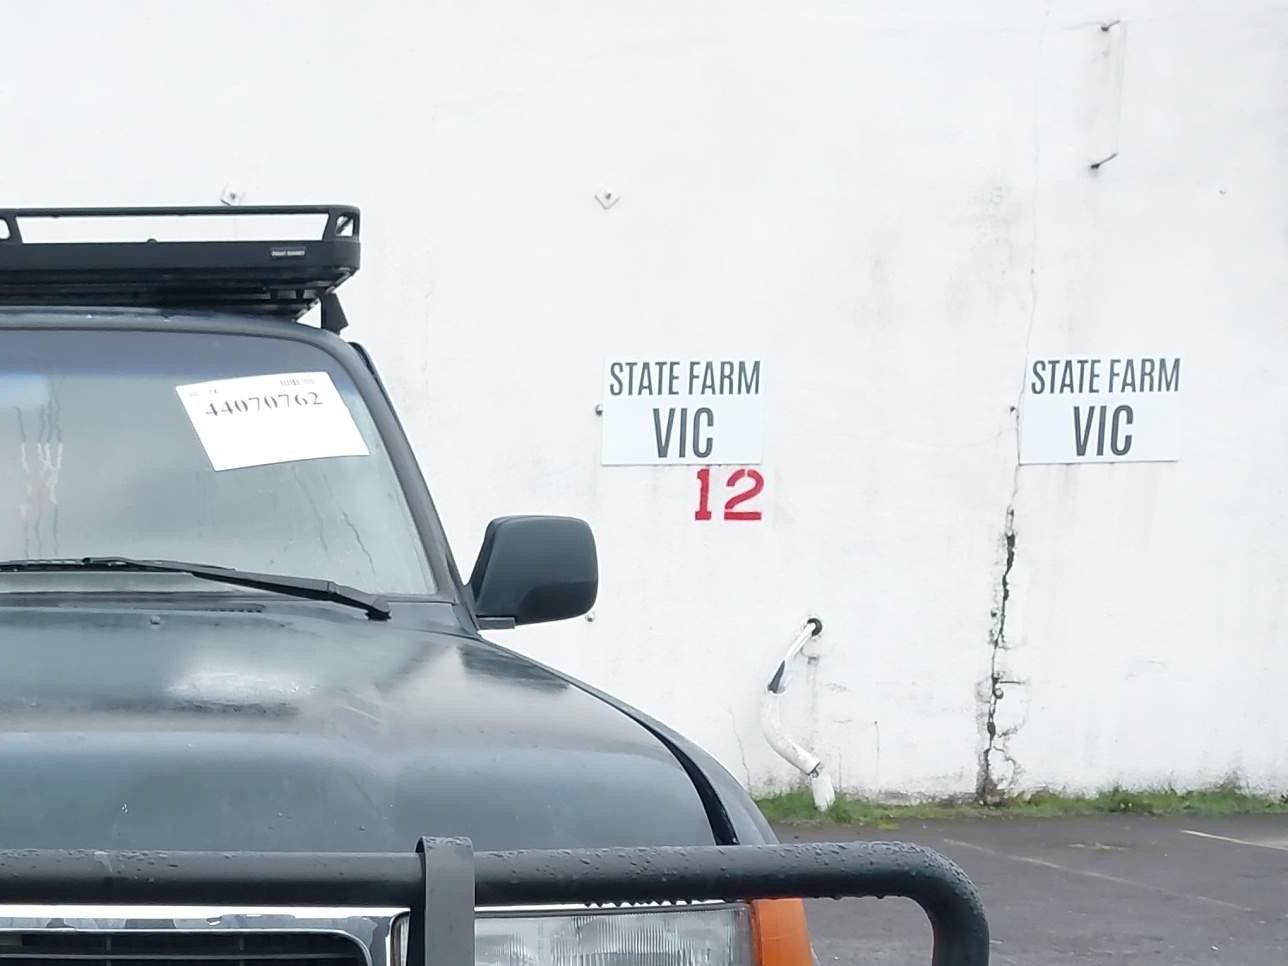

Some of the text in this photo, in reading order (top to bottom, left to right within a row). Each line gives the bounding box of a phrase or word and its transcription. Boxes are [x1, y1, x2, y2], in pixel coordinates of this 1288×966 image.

[609, 361, 760, 396] STATE FARM
[1031, 358, 1180, 395] STATE FARM
[205, 391, 324, 416] 44070762
[652, 407, 714, 458] VIC
[1073, 405, 1134, 456] VIC
[695, 468, 764, 521] 12
